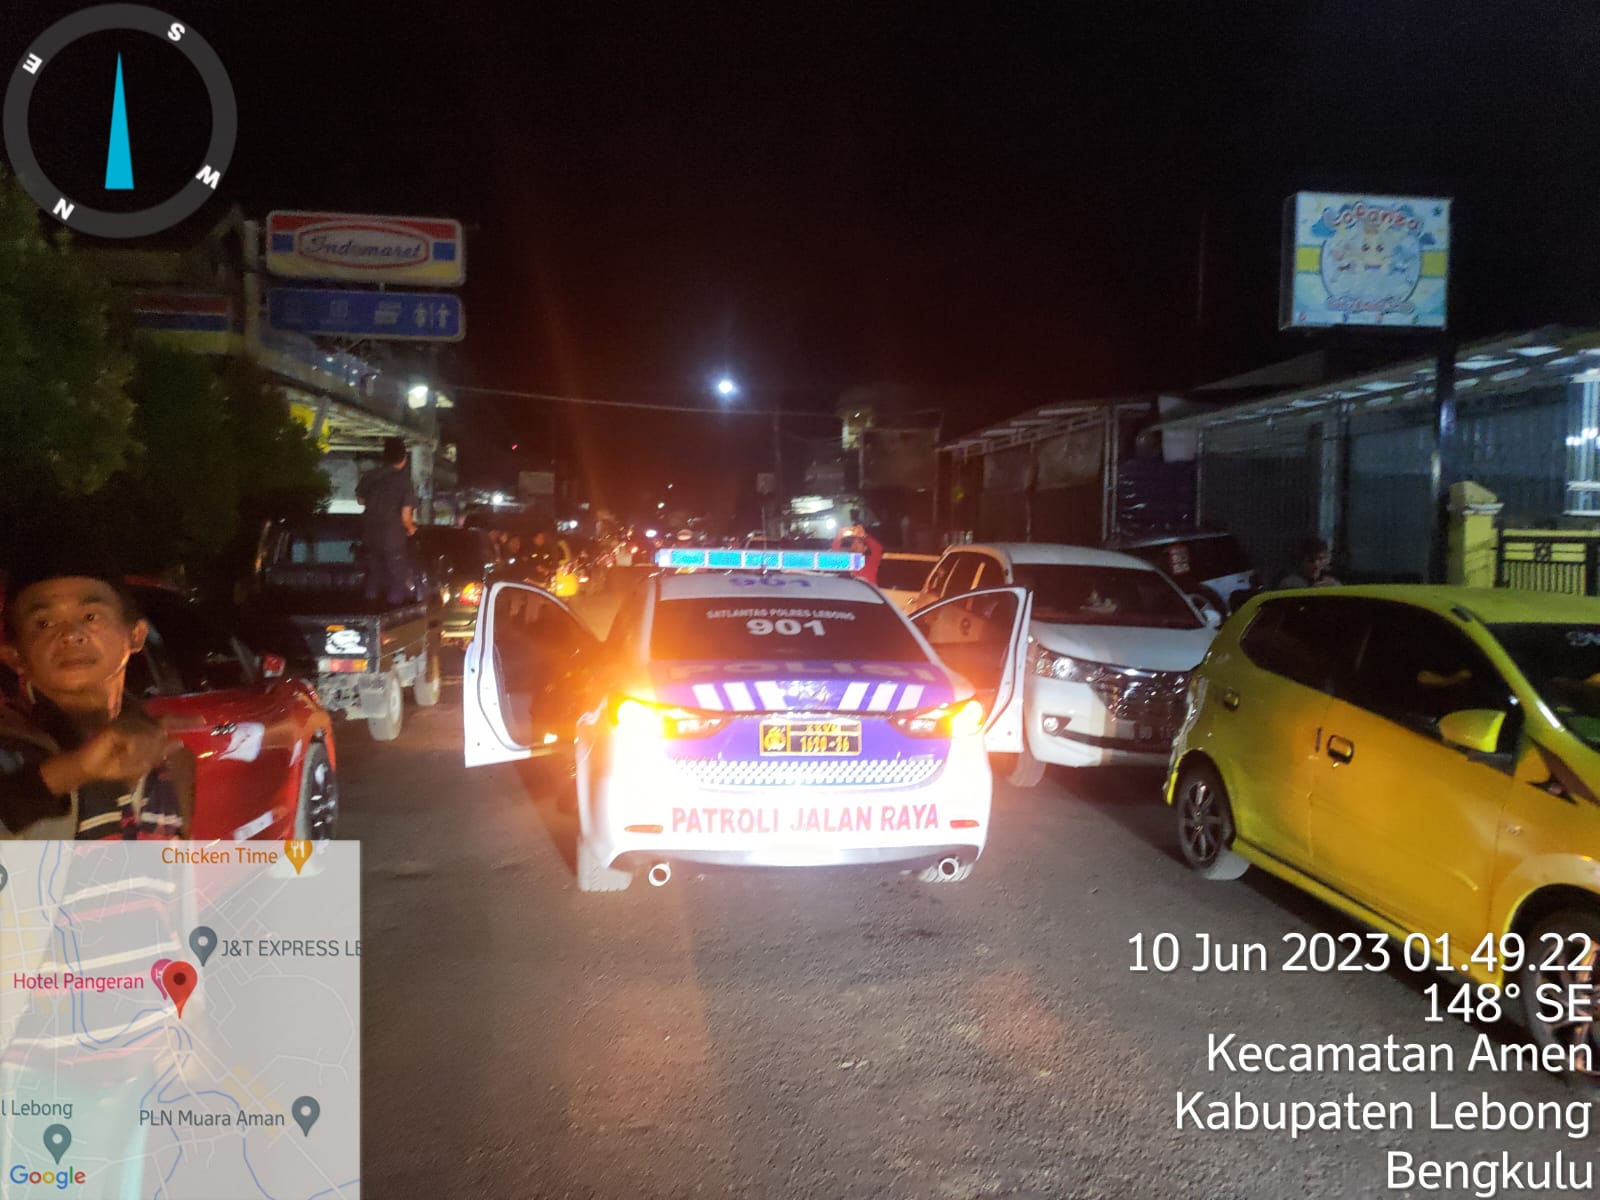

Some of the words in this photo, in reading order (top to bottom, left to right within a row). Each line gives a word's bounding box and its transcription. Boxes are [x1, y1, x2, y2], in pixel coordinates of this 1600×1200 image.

[746, 619, 827, 637] 901
[667, 661, 938, 681] POLISI
[672, 807, 779, 834] PATROLI
[790, 806, 872, 832] JALAN
[880, 803, 940, 832] RAYA
